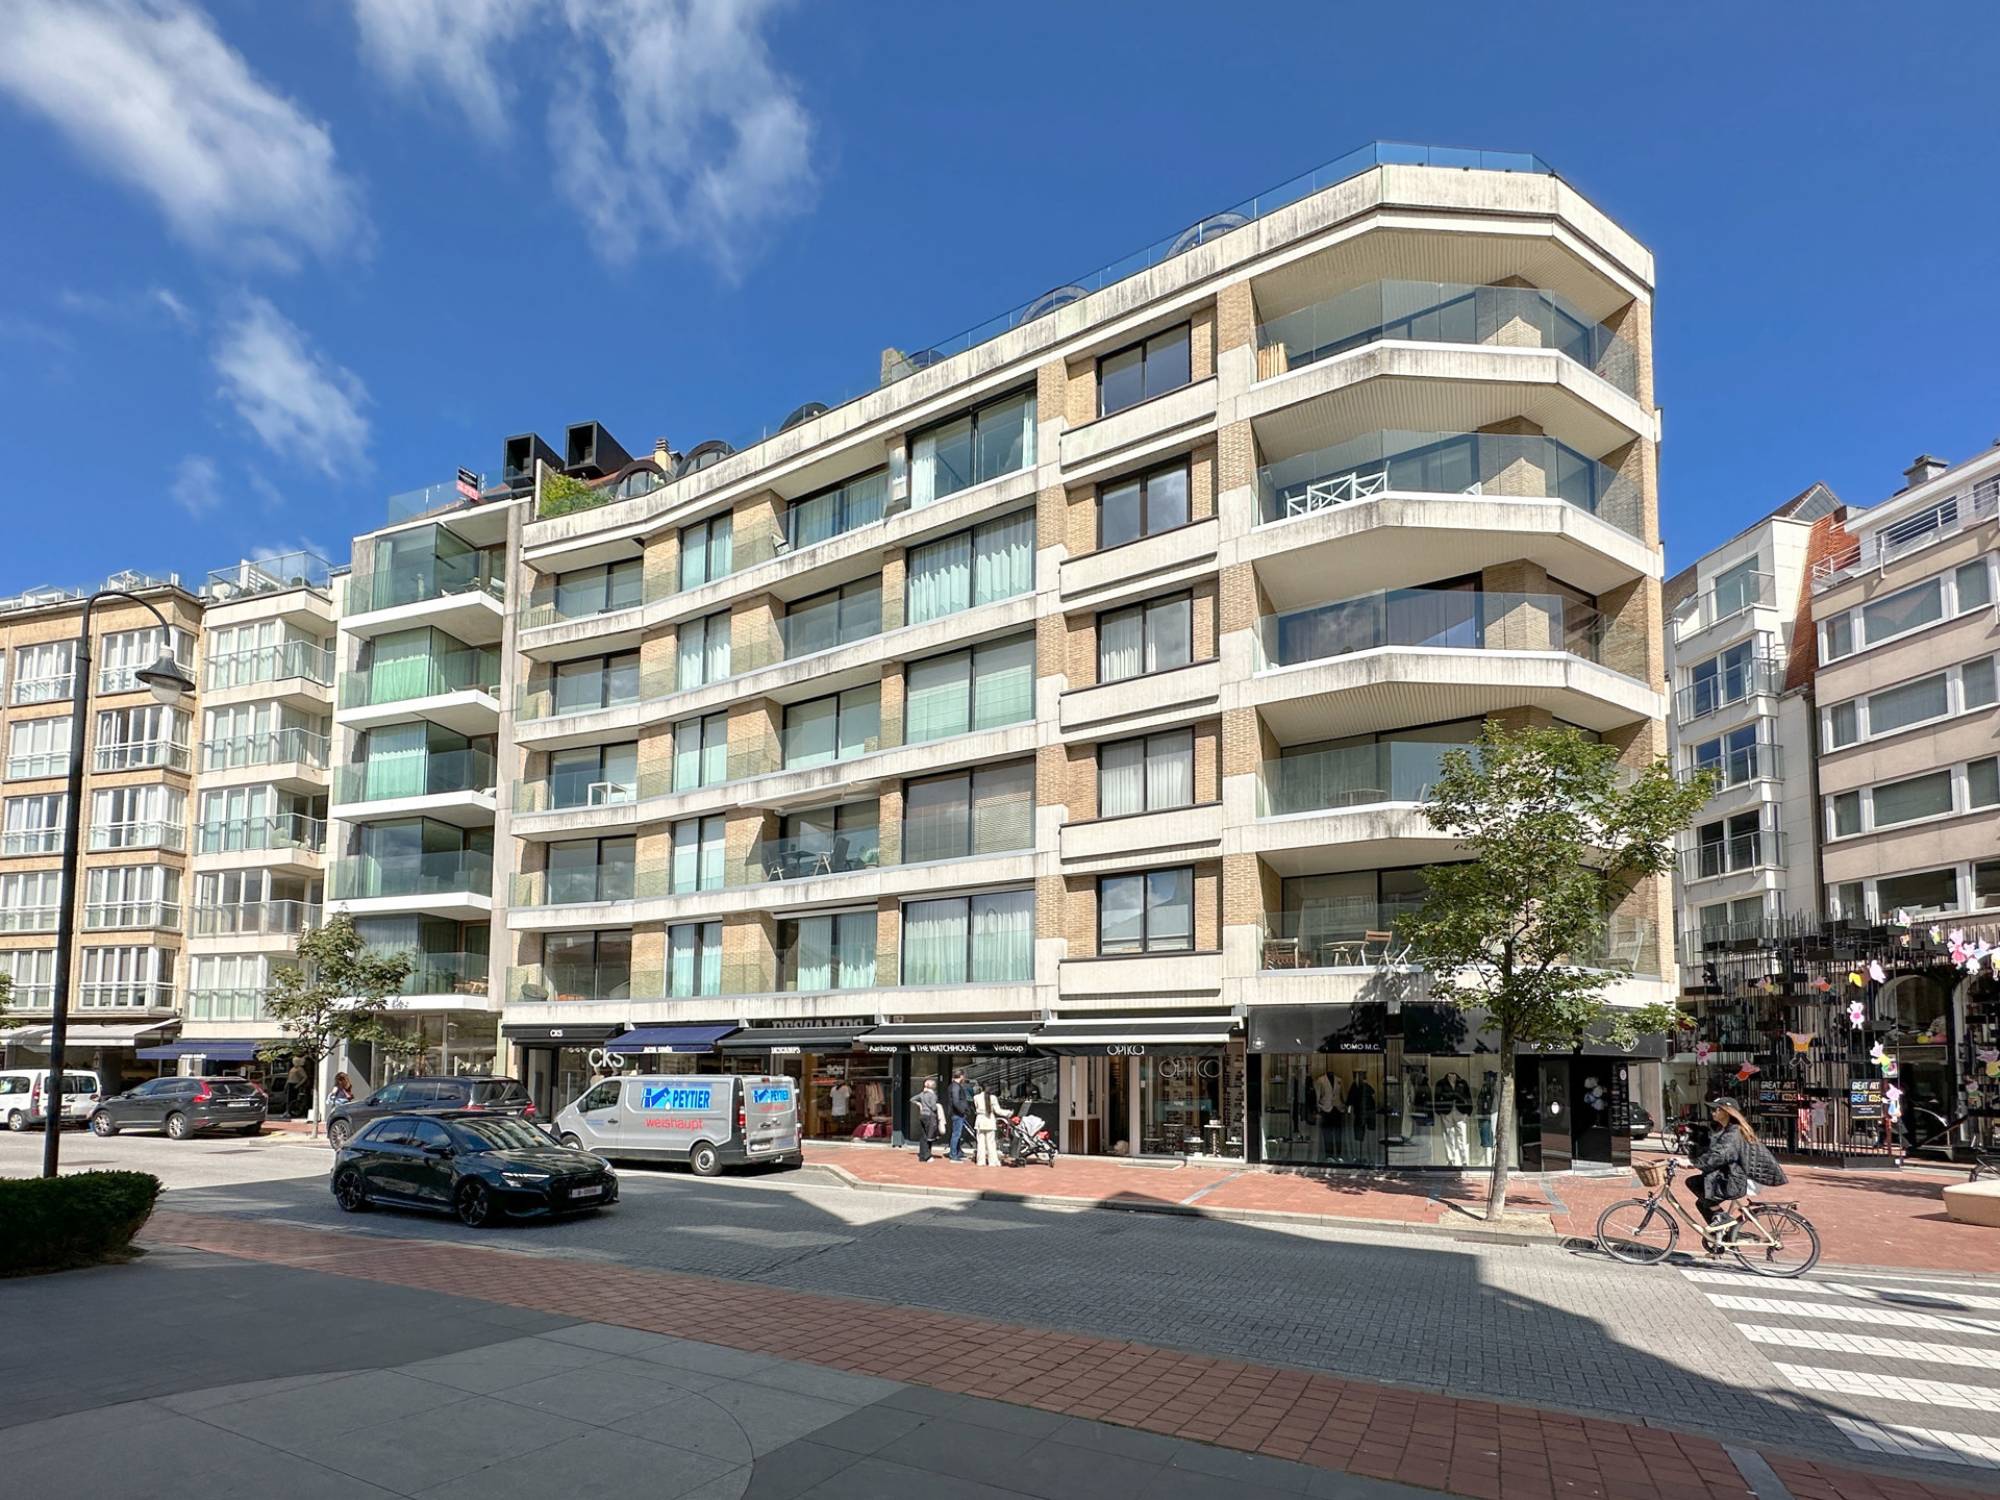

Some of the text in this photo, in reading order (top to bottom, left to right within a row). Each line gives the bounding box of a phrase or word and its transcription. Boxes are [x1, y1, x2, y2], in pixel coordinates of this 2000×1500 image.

[930, 1044, 977, 1052] WATCHHOUSE
[993, 1044, 1024, 1053] Verkoop
[672, 1089, 710, 1109] PEYTIER
